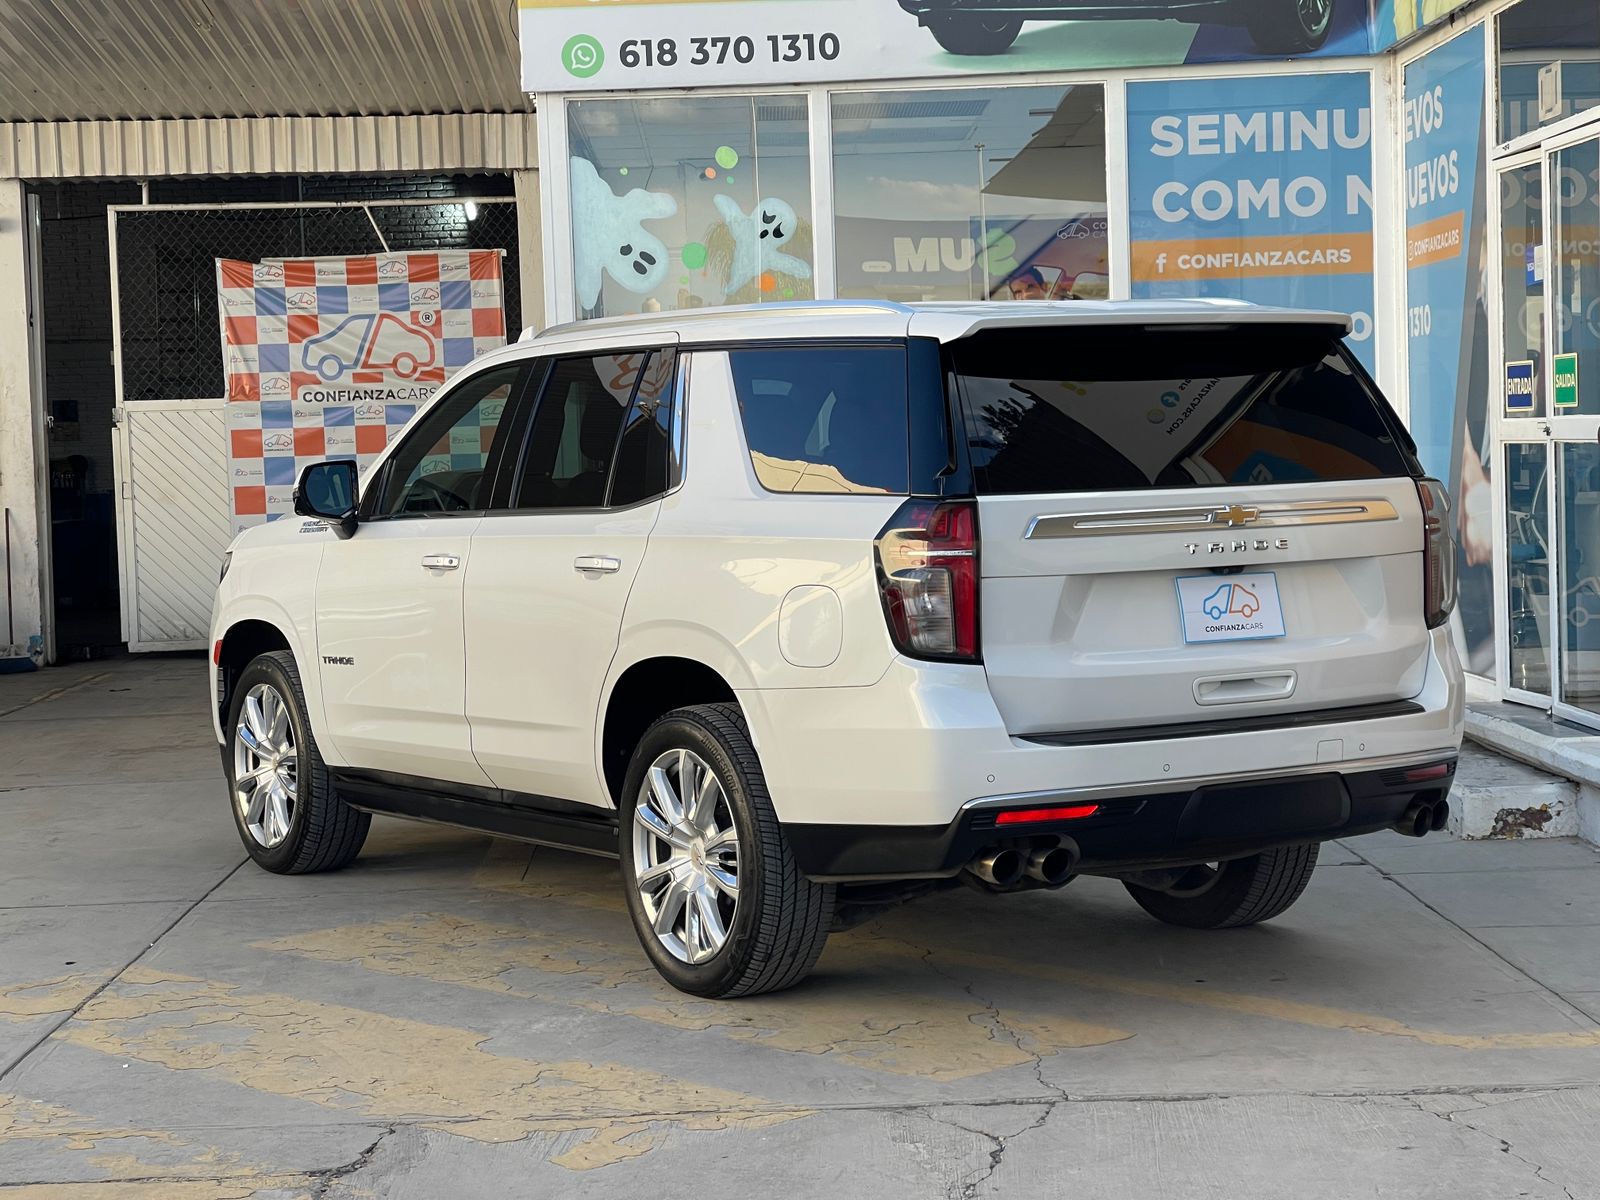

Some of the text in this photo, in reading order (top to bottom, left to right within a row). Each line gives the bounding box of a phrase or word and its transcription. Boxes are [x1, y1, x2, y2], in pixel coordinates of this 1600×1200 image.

[619, 32, 840, 68] 618 370 1310
[1405, 85, 1443, 143] EVOS
[1150, 107, 1371, 157] SEMINU
[1405, 149, 1459, 210] UEVOS
[1152, 176, 1327, 223] COMO
[1414, 228, 1460, 256] CONFIANZACARS
[1178, 248, 1352, 270] CONFIANZACARS
[1409, 303, 1431, 337] 1310
[1507, 377, 1533, 395] ENTRADA
[1555, 373, 1576, 388] SALIDA
[302, 387, 438, 403] CONFIANZACARS
[1184, 537, 1289, 555] TAHOE
[1205, 622, 1264, 633] CONFIANZACARS
[322, 656, 354, 665] TAHOE
